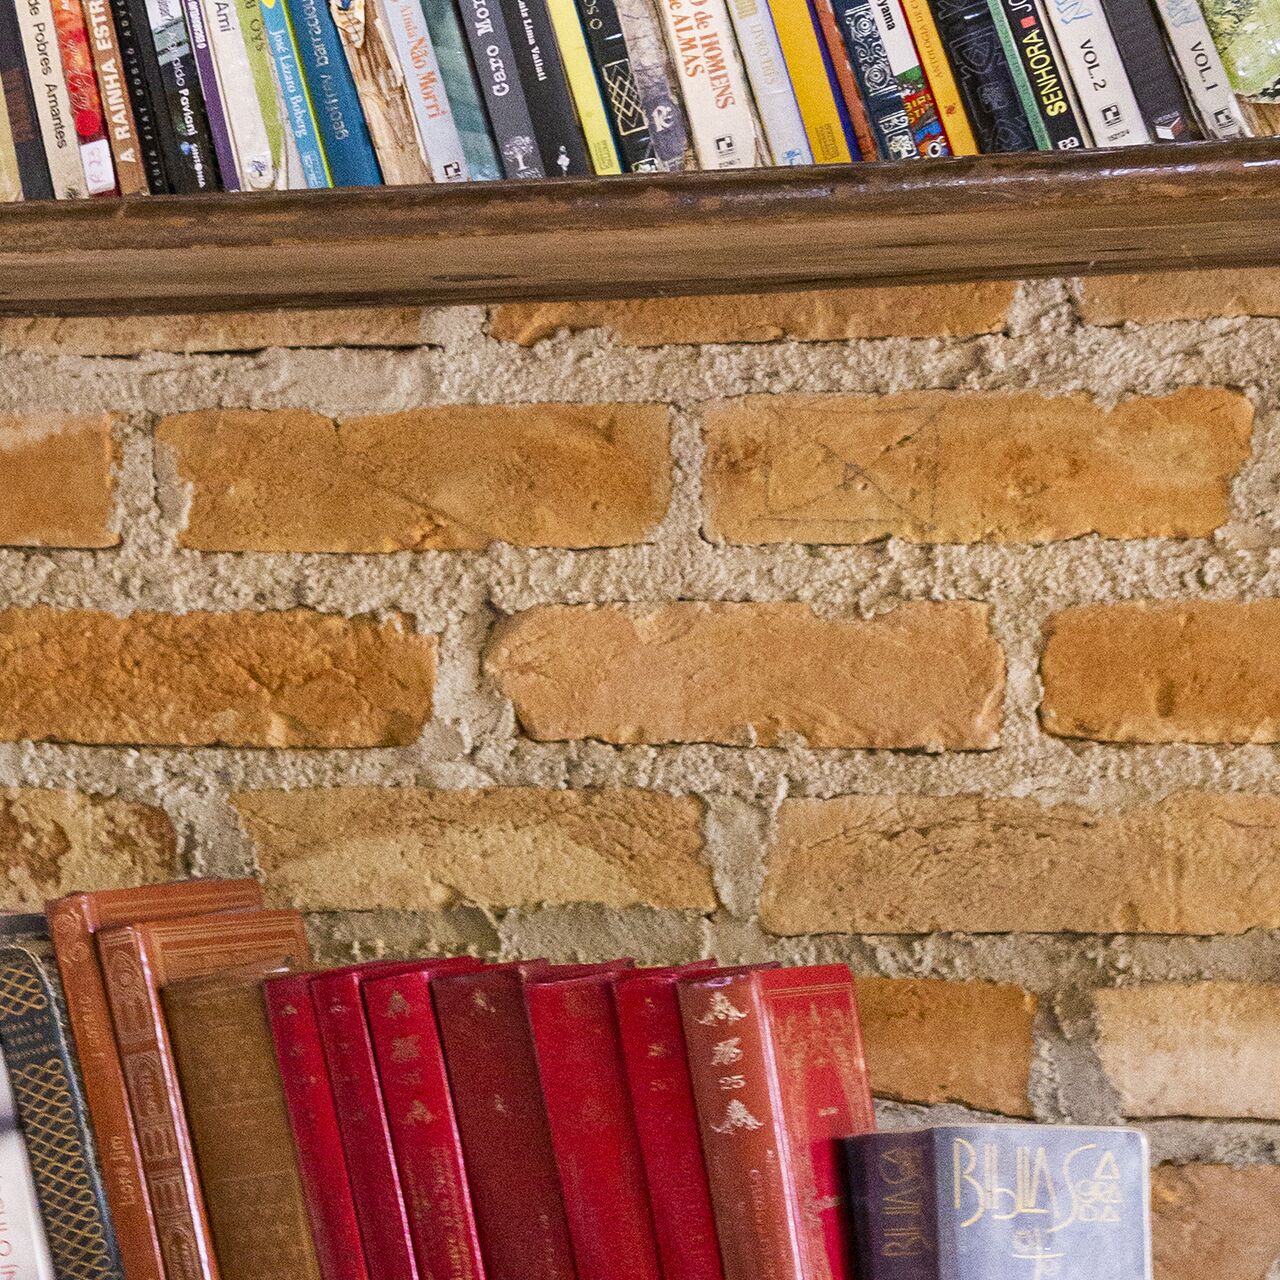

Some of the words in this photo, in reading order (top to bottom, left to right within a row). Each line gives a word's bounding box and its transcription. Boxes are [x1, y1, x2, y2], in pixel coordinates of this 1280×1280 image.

[250, 19, 266, 52] SÃO
[270, 28, 288, 56] José
[523, 19, 536, 45] Lima
[694, 10, 714, 29] de
[486, 45, 511, 97] Caro
[671, 13, 706, 80] ALMAS
[698, 32, 737, 111] HOMENS
[1022, 28, 1068, 117] SENHORA
[1080, 38, 1100, 81] VOL.
[1093, 78, 1108, 92] 2
[1189, 41, 1208, 81] VOL.
[1204, 81, 1219, 93] 1
[32, 21, 52, 77] Pobres
[45, 82, 68, 150] Amantes
[278, 56, 297, 94] Lázaro
[100, 58, 131, 145] RAINHA
[287, 95, 308, 138] Boberg
[119, 147, 137, 164] A
